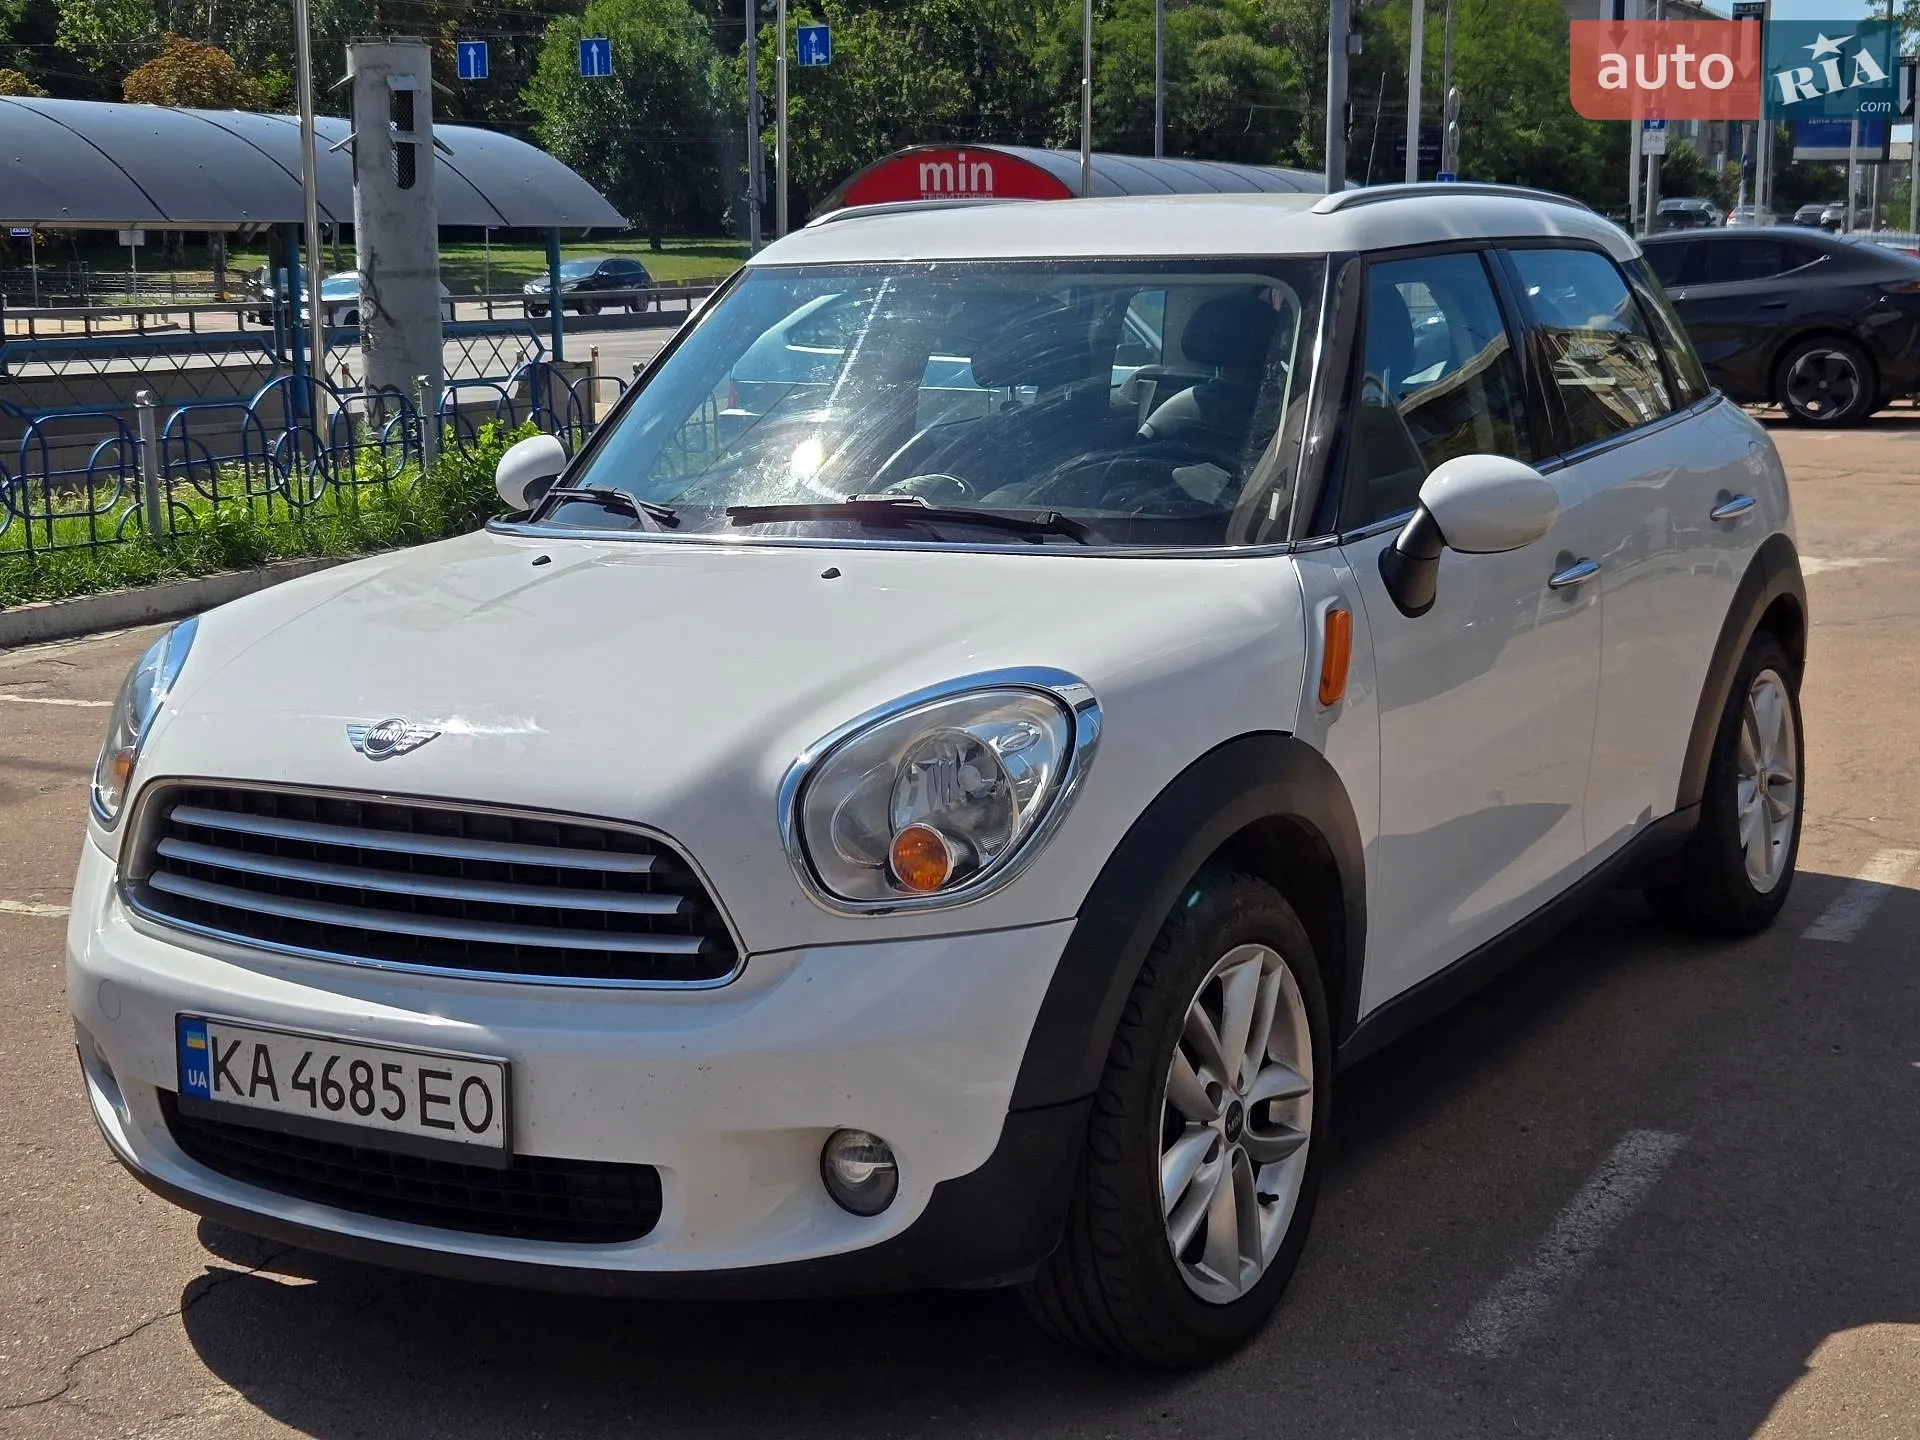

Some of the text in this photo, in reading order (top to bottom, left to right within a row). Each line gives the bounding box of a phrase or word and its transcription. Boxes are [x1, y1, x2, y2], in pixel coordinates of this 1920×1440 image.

[919, 152, 993, 191] min
[368, 728, 402, 742] MINI
[188, 1069, 208, 1089] UA
[291, 1051, 407, 1121] 4685
